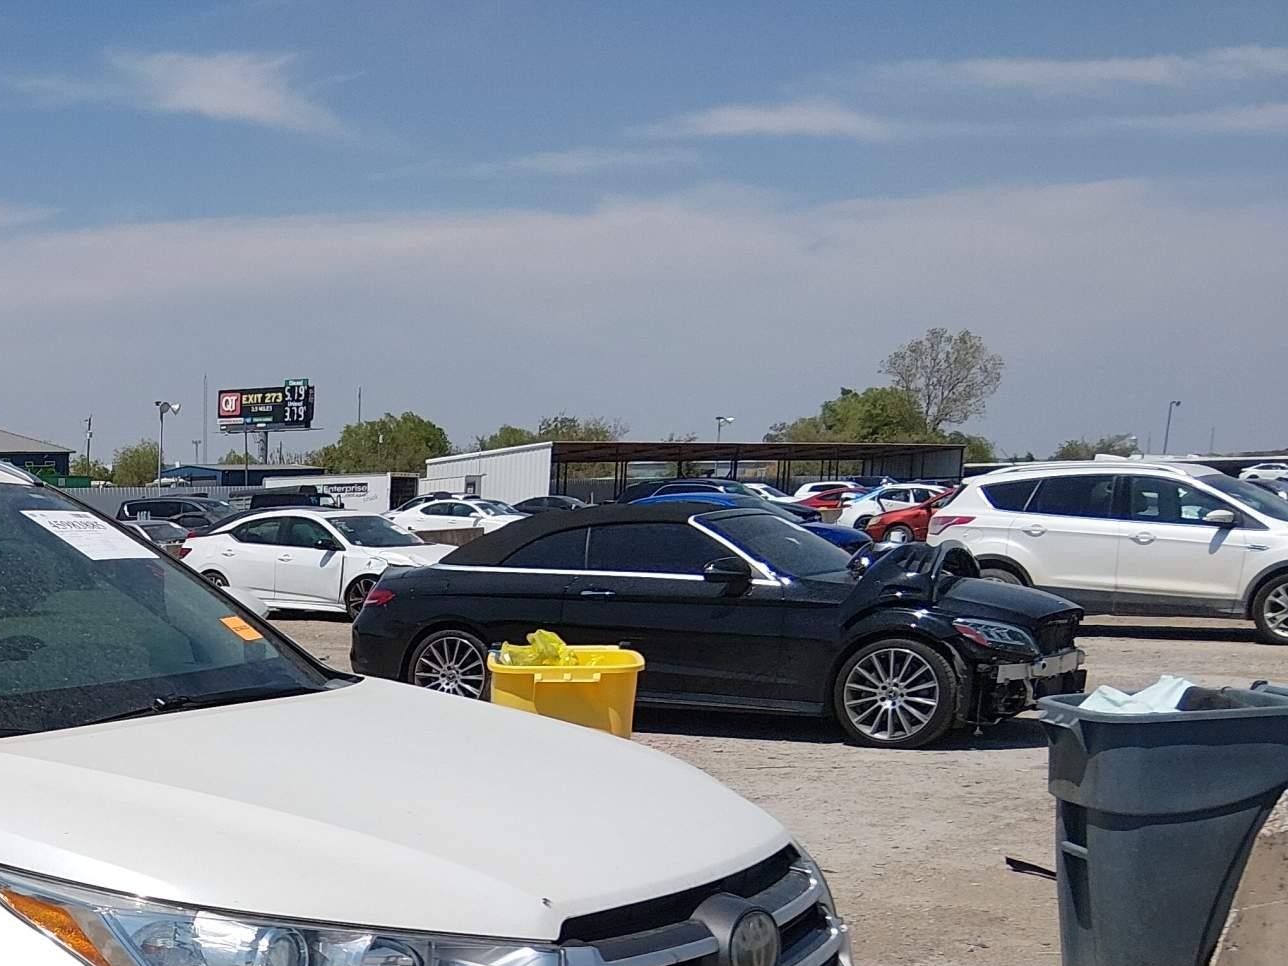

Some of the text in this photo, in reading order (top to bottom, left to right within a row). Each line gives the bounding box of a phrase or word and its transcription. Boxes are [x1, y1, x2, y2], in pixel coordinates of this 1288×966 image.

[221, 396, 238, 413] QT
[242, 392, 283, 405] EXIT 273
[323, 484, 368, 493] Enterprise
